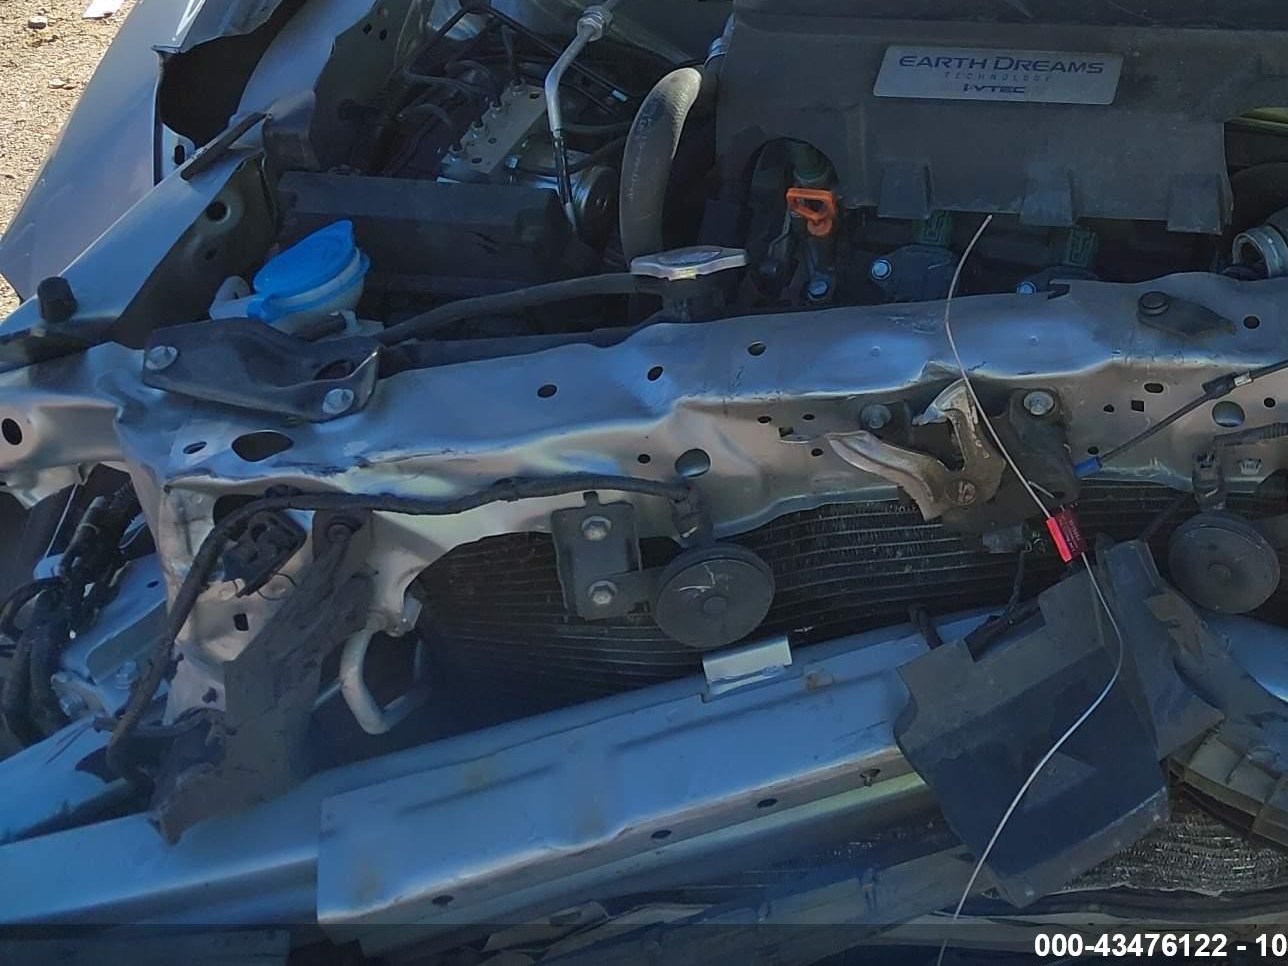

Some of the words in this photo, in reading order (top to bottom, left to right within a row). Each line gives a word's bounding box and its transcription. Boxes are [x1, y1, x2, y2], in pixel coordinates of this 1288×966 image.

[899, 55, 987, 70] EARTH
[993, 56, 1105, 74] DREAMS
[944, 71, 1053, 82] TECHNOLOGY
